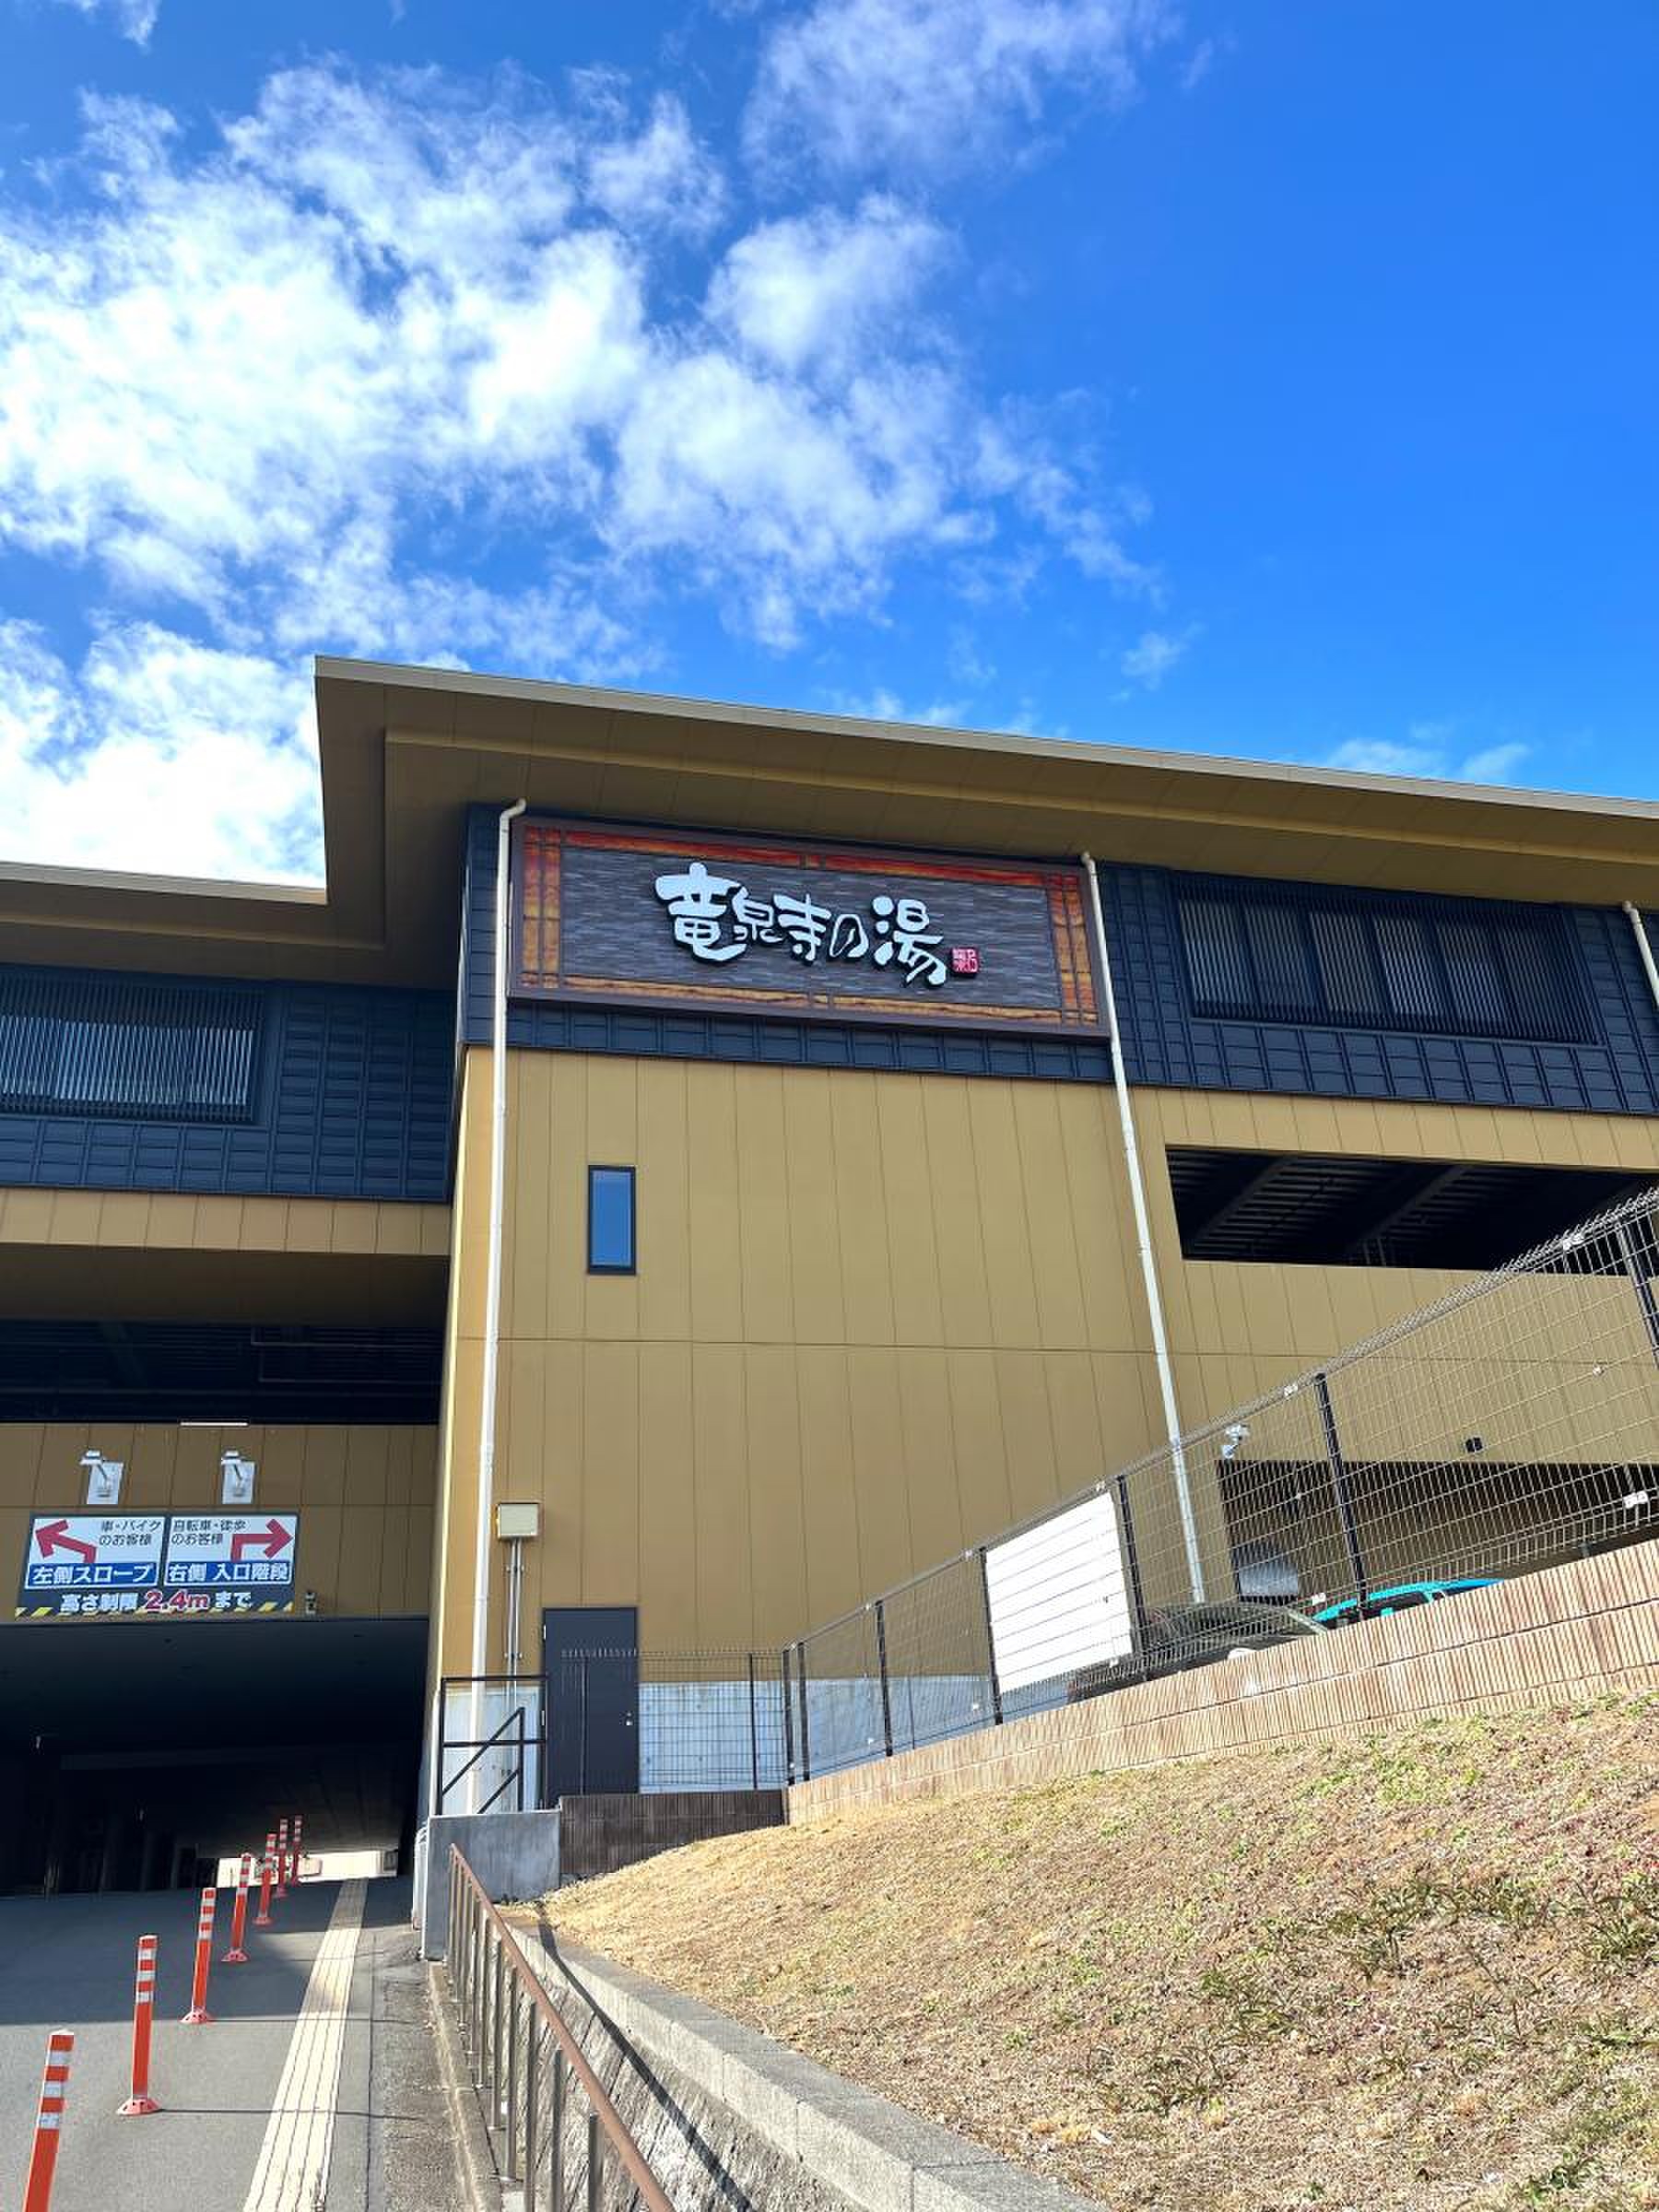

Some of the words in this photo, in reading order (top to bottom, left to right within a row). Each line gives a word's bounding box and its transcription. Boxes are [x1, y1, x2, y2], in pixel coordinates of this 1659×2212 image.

[655, 862, 947, 986] 竜泉寺の湯
[99, 1533, 152, 1546] のお客様
[171, 1533, 223, 1545] のお客様
[32, 1565, 155, 1585] 左側スロープ
